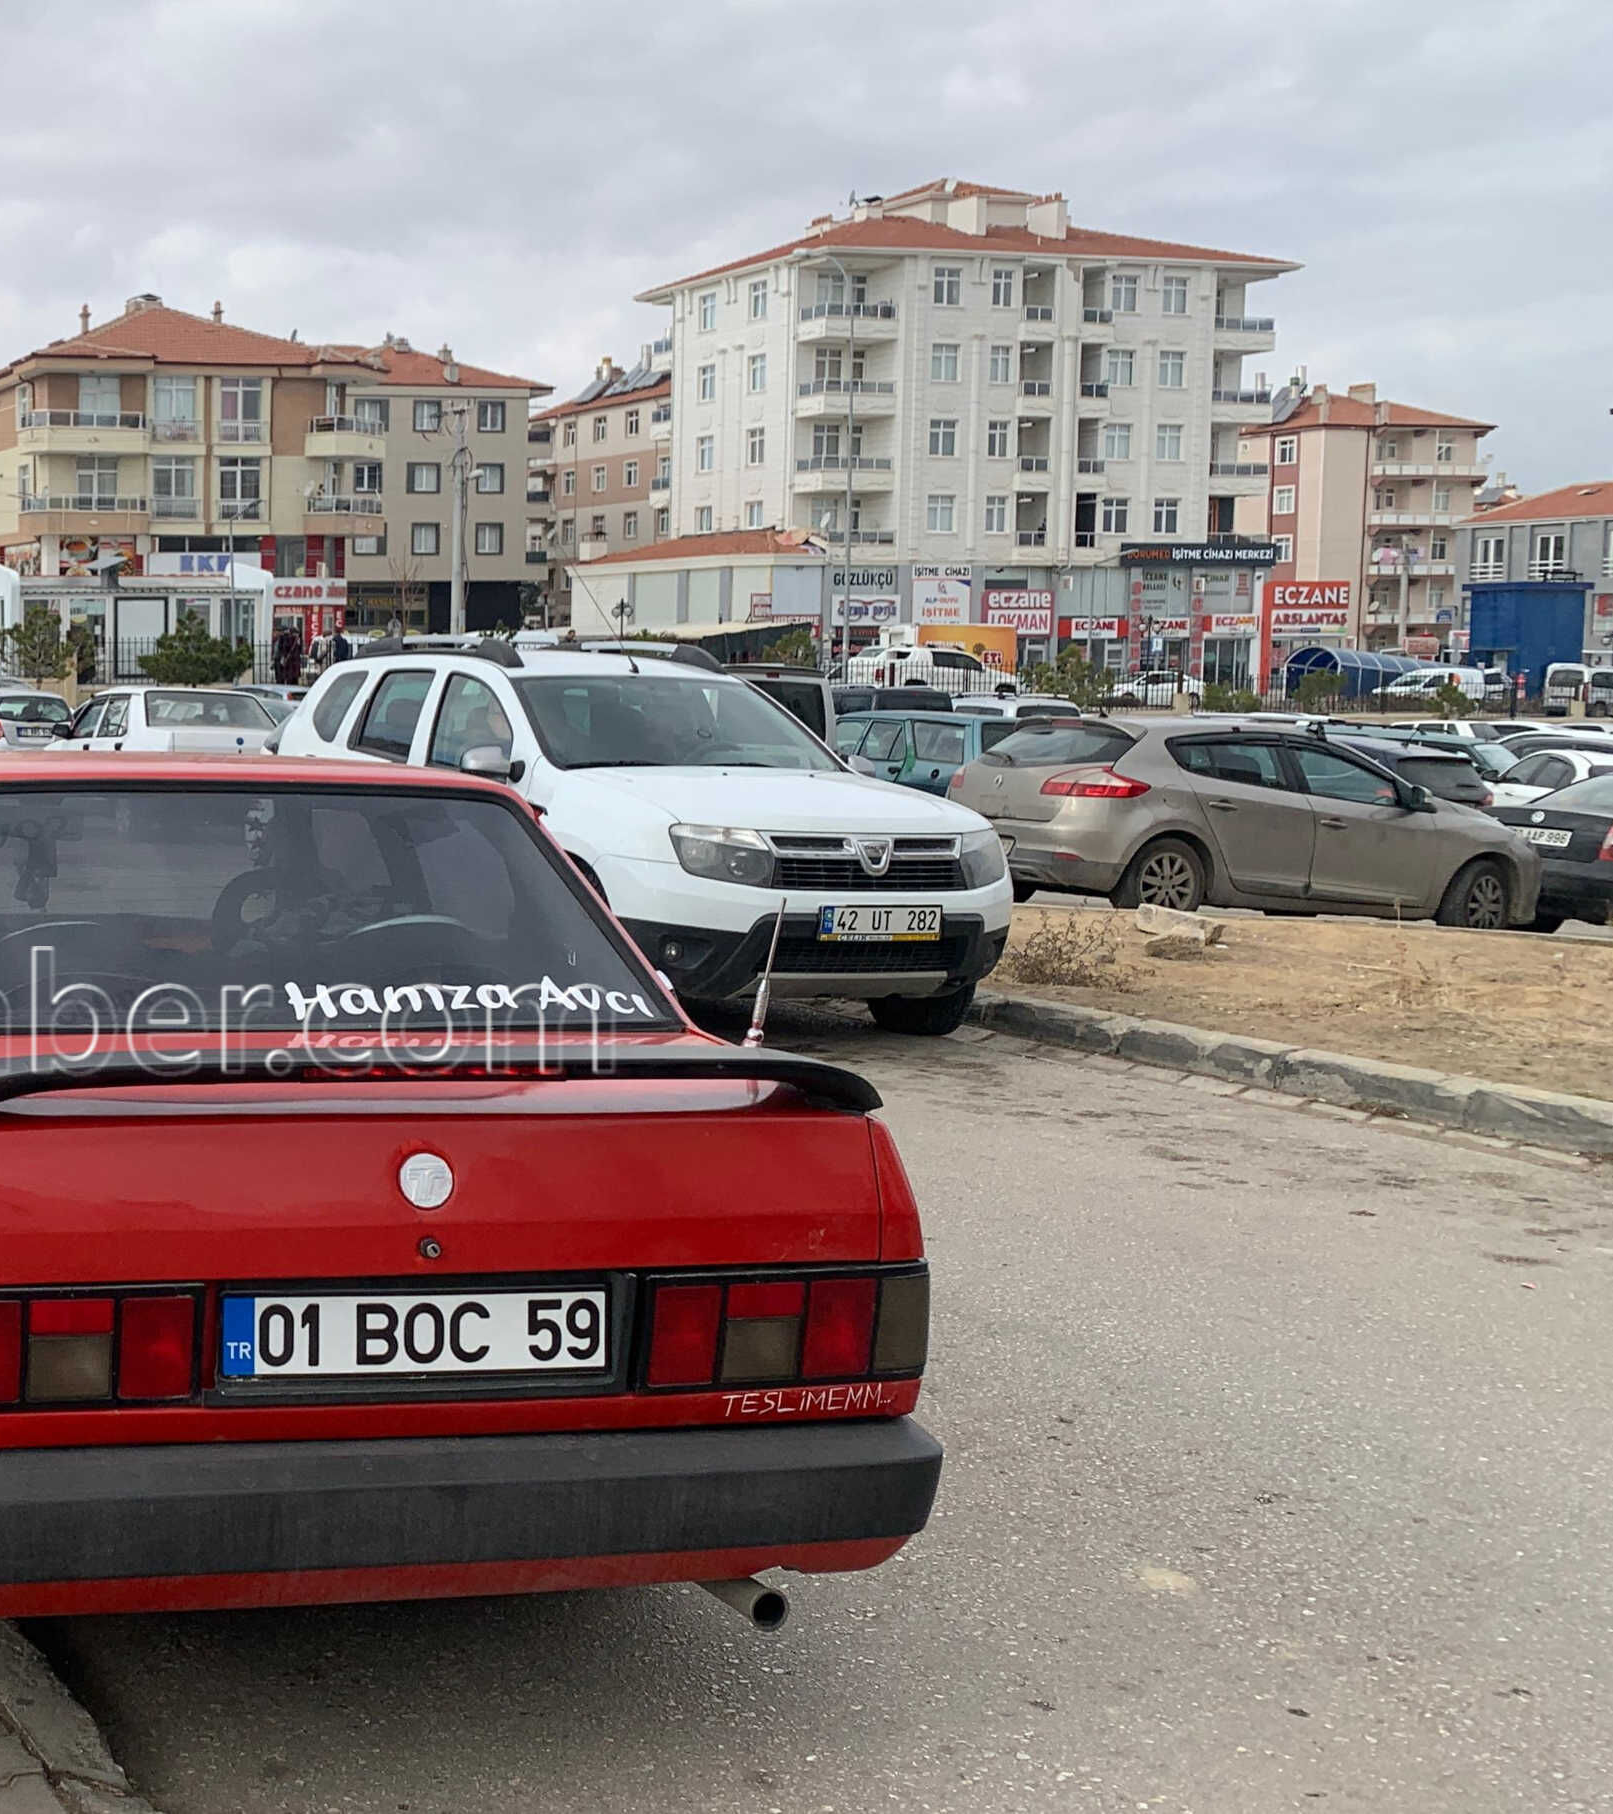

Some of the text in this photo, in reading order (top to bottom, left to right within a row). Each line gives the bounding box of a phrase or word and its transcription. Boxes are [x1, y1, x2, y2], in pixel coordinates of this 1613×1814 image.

[1172, 548, 1201, 561] İŞİTME
[1203, 548, 1234, 560] CİHAZI
[1235, 547, 1274, 560] MERKEZİ
[988, 591, 1051, 608] eczane
[1273, 586, 1349, 605] ECZANE
[1074, 621, 1117, 631] ECZANE
[1160, 619, 1189, 630] ZANE
[1273, 612, 1348, 627] ARSLANTAŞ
[837, 910, 859, 931] 42
[871, 910, 893, 931] UT
[907, 910, 937, 932] 282
[284, 980, 519, 1020] Hamza
[226, 1296, 602, 1368] TR 01 BOC 59
